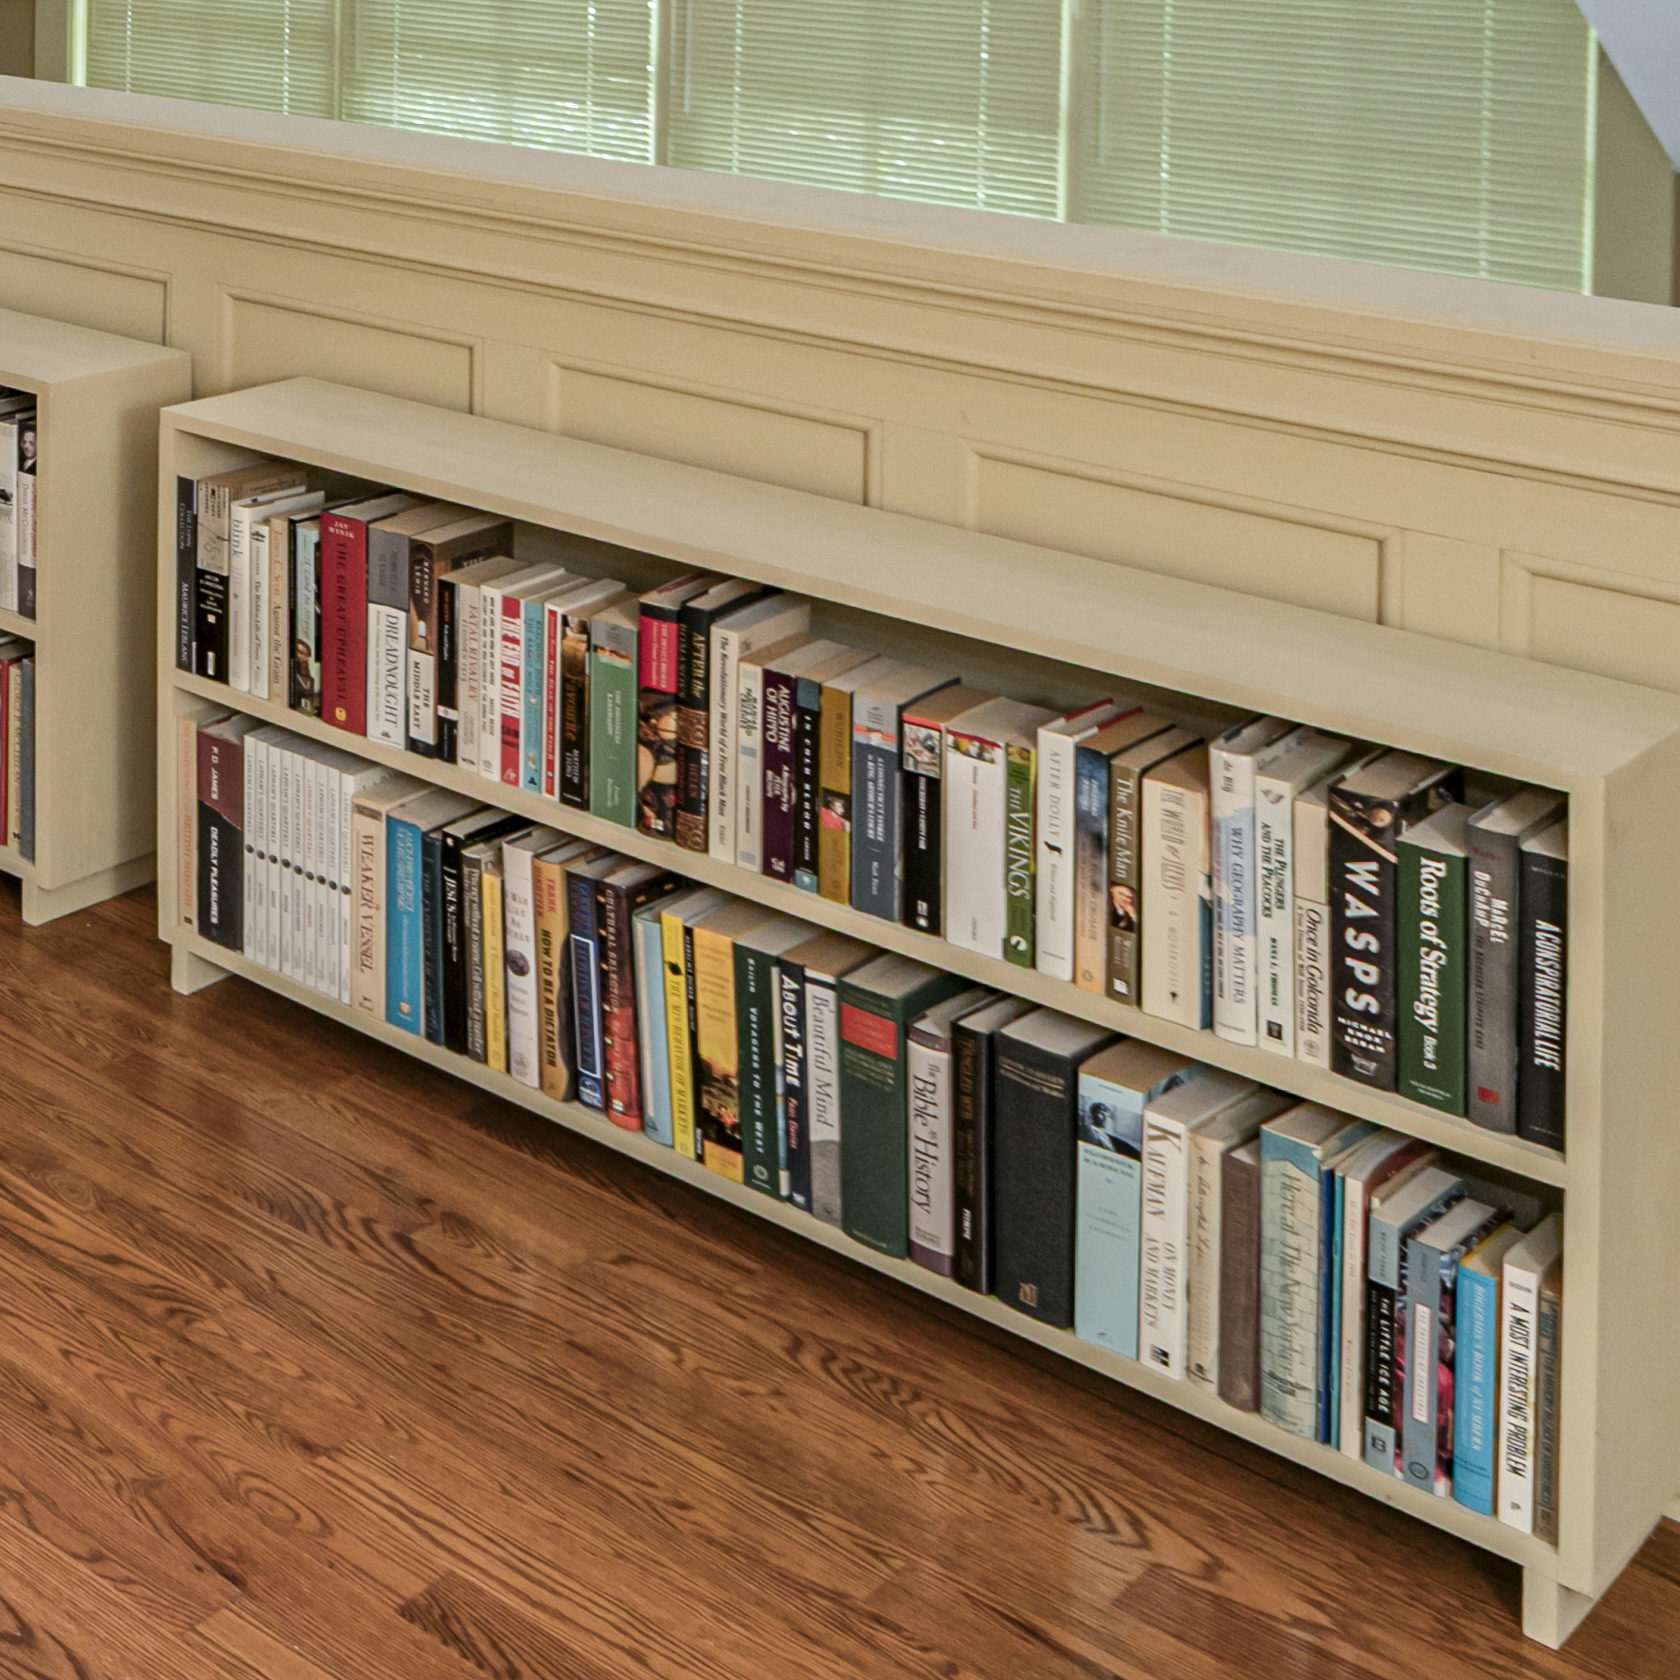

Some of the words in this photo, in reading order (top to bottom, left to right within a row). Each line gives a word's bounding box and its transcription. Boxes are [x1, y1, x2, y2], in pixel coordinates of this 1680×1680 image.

[231, 519, 244, 559] blink
[181, 582, 189, 623] MAURICE
[273, 602, 282, 636] Against
[469, 605, 478, 643] FATAL
[501, 616, 520, 640] THE
[720, 636, 728, 649] The
[181, 625, 189, 665] LEBLANC
[273, 639, 282, 654] the
[501, 642, 520, 667] END
[692, 632, 706, 677] AFTER
[273, 656, 282, 684] Grain
[384, 613, 398, 725] DREADNOUGHT
[469, 644, 478, 702] RIVALRY
[501, 681, 520, 719] FAITH
[778, 684, 790, 753] AUGUSTINE
[720, 712, 728, 736] World
[766, 705, 777, 743] HIPPO
[1048, 748, 1060, 789] AFTER
[1117, 778, 1133, 804] The
[1048, 794, 1060, 838] DOLLY
[1116, 808, 1133, 844] Knife
[1262, 822, 1273, 843] AND
[1008, 810, 1030, 900] VIKINGS
[1230, 827, 1244, 857] WHY
[1262, 845, 1273, 863] THE
[1274, 839, 1285, 858] THE
[360, 833, 374, 908] WEAKER
[1116, 846, 1132, 878] Man
[210, 866, 218, 924] PLEASURES
[445, 875, 457, 913] JESUS
[1231, 863, 1244, 940] GEOGRAPHY
[1261, 866, 1274, 919] PEACOCKS
[1274, 860, 1286, 910] PLUNGERS
[1420, 857, 1447, 917] Roots
[1474, 871, 1491, 927] DUCHAMP
[1306, 909, 1322, 946] Once
[1343, 860, 1379, 1015] WASPS
[1420, 920, 1448, 950] of
[1489, 898, 1509, 944] MARCEL
[1535, 920, 1560, 932] A
[361, 913, 374, 974] VESSEL
[541, 928, 552, 958] HOW
[1306, 947, 1322, 962] in
[542, 960, 552, 976] TO
[543, 979, 553, 995] BE
[1231, 945, 1246, 1004] MATTERS
[1534, 932, 1561, 1039] CONSPIRATORIAL
[1306, 965, 1323, 1035] Golconda
[1414, 948, 1447, 1033] Strategy
[545, 1009, 557, 1068] DICTATOR
[812, 995, 834, 1072] Beautiful
[1338, 1017, 1393, 1039] MICHAEL
[1344, 1035, 1385, 1053] BERAN
[1347, 1028, 1382, 1044] KNOX
[1422, 1035, 1437, 1058] Book
[1423, 1059, 1437, 1070] 3
[1533, 1040, 1560, 1072] LIFE
[815, 1079, 834, 1128] Mind
[912, 1074, 938, 1128] Bible
[911, 1131, 940, 1215] History
[1146, 1121, 1182, 1220] KAUFMAN
[1280, 1172, 1301, 1218] Here
[1145, 1233, 1159, 1263] AND
[1165, 1242, 1176, 1263] ON
[1280, 1241, 1301, 1269] The
[1144, 1267, 1159, 1329] MARKETS
[1161, 1265, 1176, 1315] MONEY
[1280, 1269, 1301, 1318] New
[1509, 1302, 1530, 1314] A
[1280, 1316, 1300, 1377] Yorker
[1379, 1319, 1390, 1362] LITTLE
[1508, 1315, 1530, 1347] MOST
[1379, 1364, 1390, 1385] ICE
[1507, 1349, 1529, 1421] INTERESTING
[1378, 1388, 1390, 1414] AGE
[1506, 1423, 1527, 1479] PROBLEM
